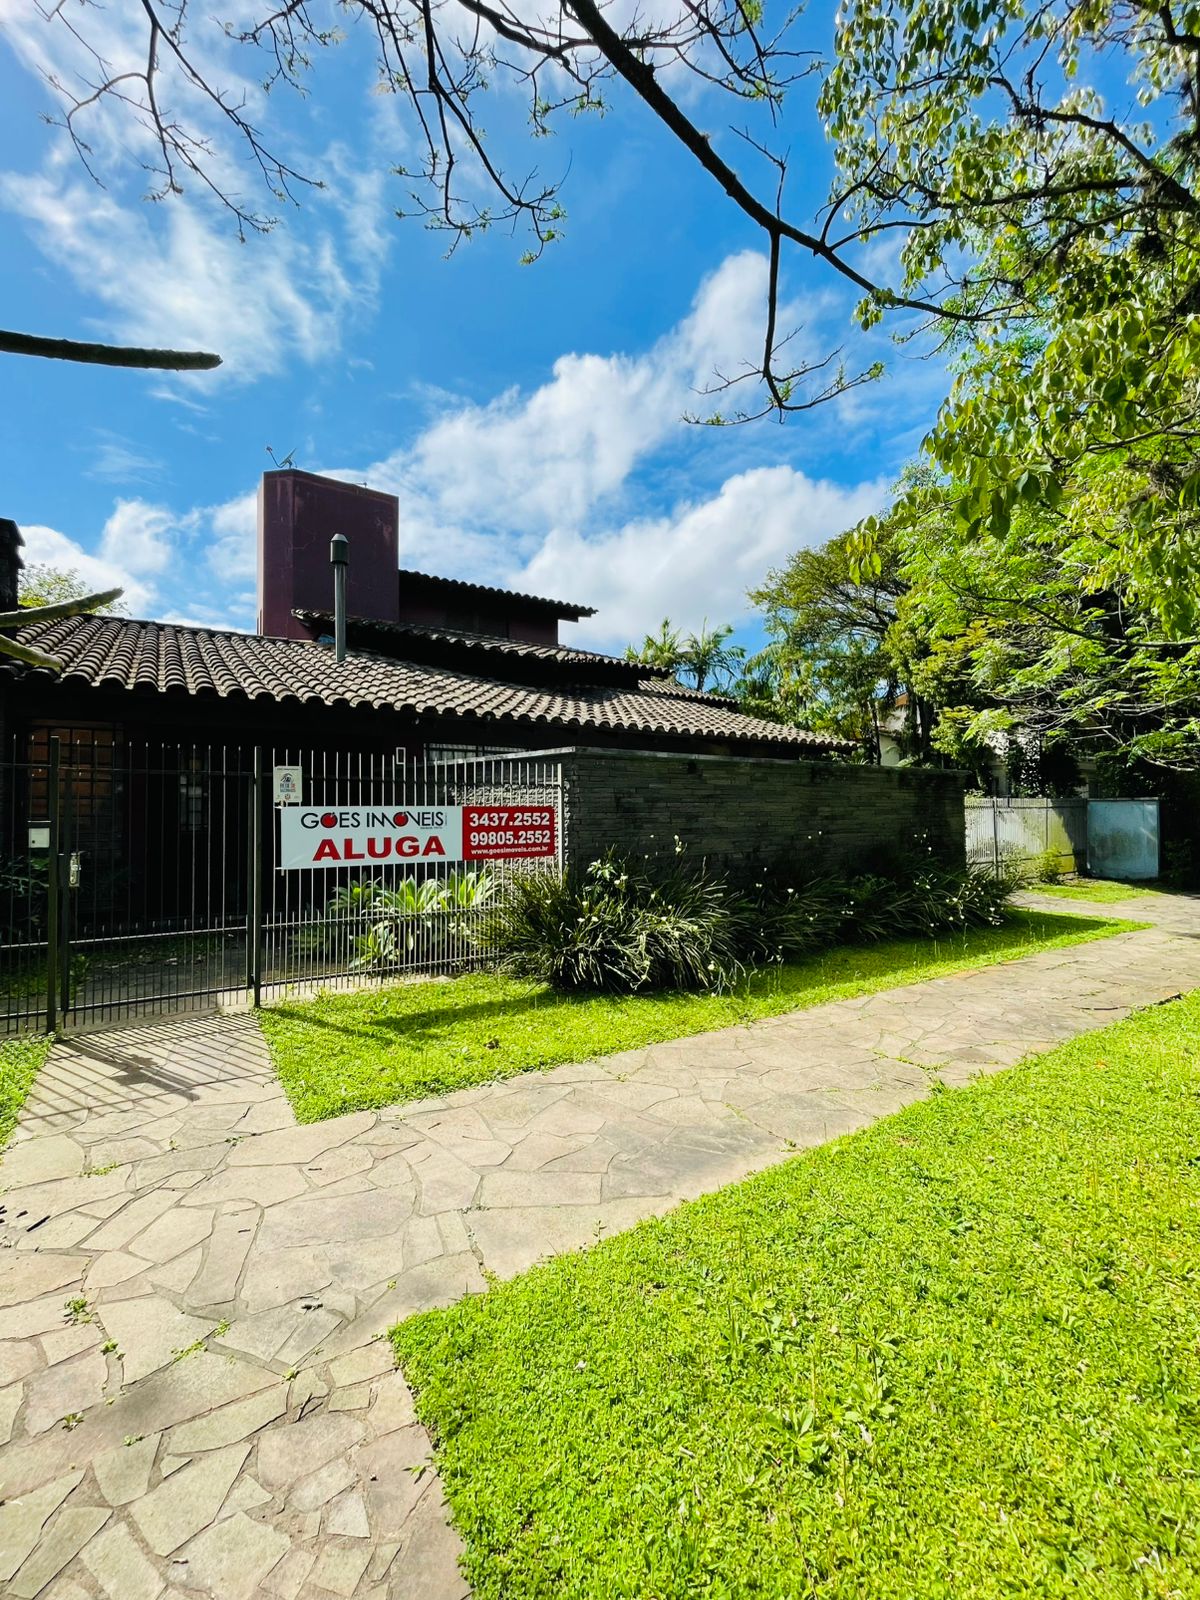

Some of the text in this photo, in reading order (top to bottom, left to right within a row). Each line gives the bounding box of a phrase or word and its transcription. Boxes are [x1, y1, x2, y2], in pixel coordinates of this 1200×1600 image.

[469, 812, 550, 827] 3437.2552
[470, 830, 551, 846] 99805.2552
[312, 835, 446, 861] ALUGA
[471, 845, 549, 855] www.goesimoveis.com.br
